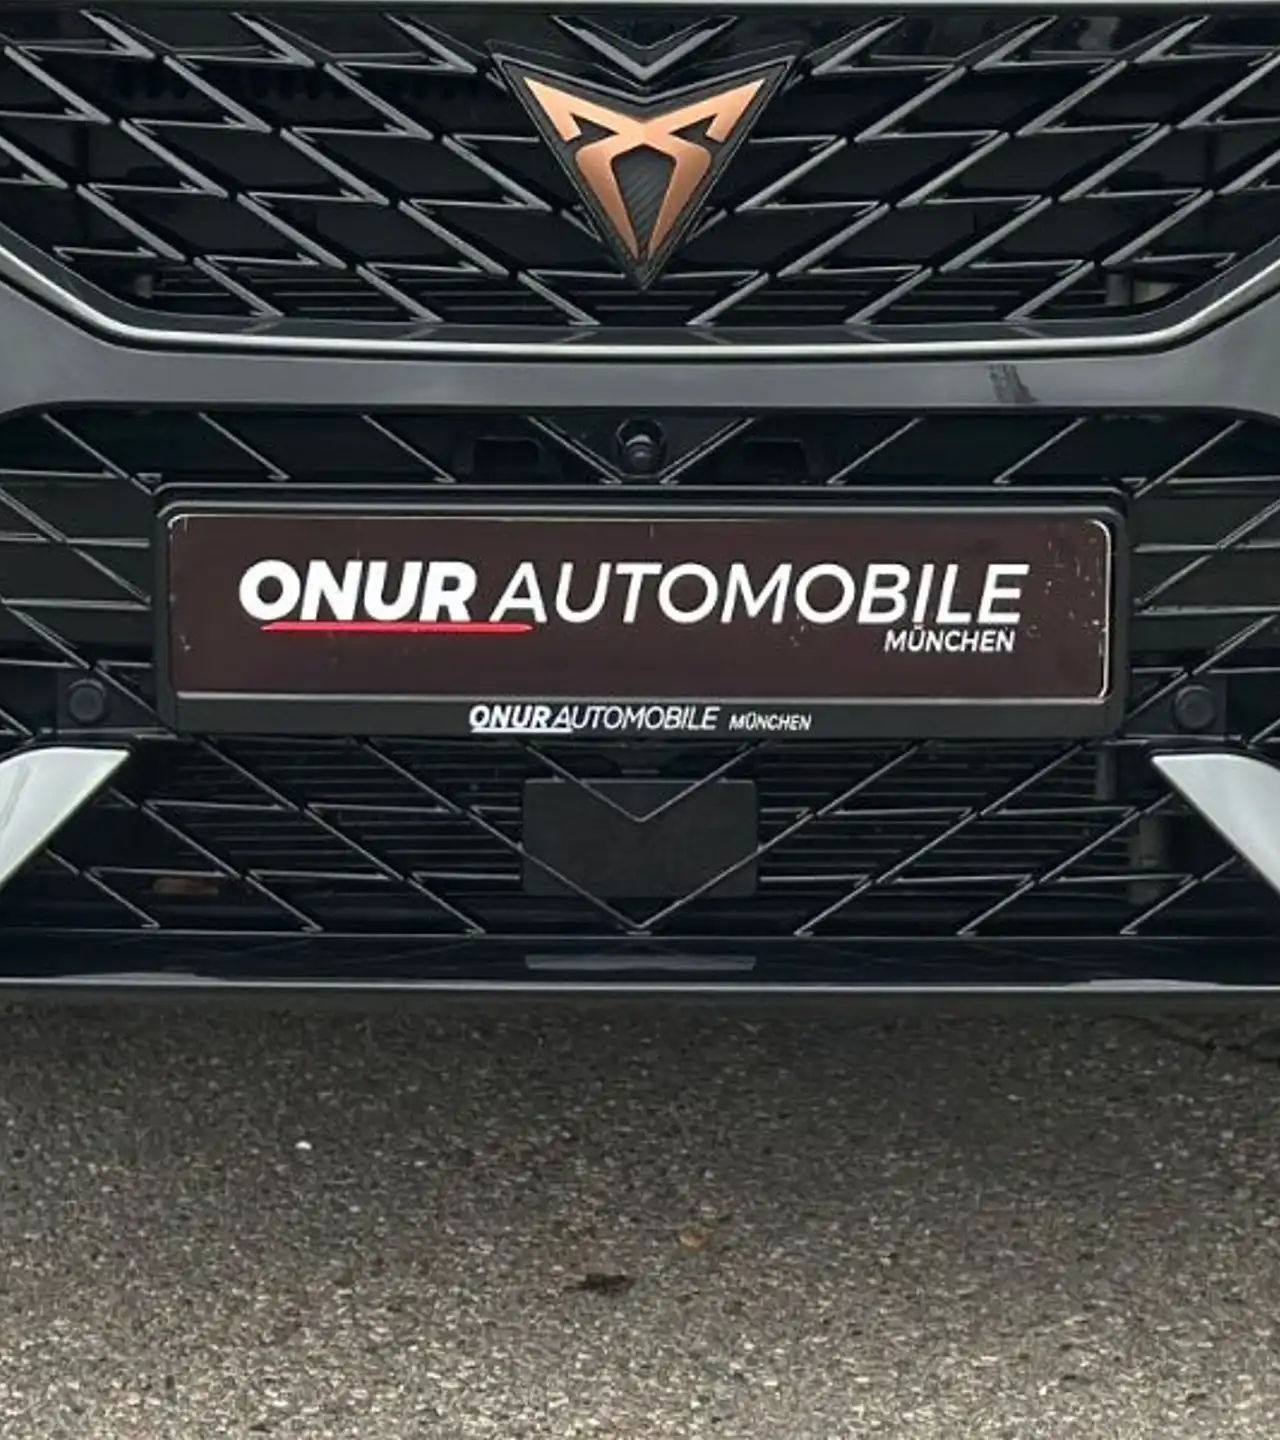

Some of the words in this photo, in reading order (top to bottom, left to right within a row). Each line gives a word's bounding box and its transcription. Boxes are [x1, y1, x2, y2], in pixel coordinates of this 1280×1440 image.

[238, 559, 478, 622] ONUR
[489, 561, 1030, 625] AUTOMOBILE
[883, 625, 1017, 653] MÜNCHEN
[469, 705, 551, 730] ONUR
[550, 705, 720, 731] AUTOMOBILE
[728, 711, 812, 731] MÜNCHEN
